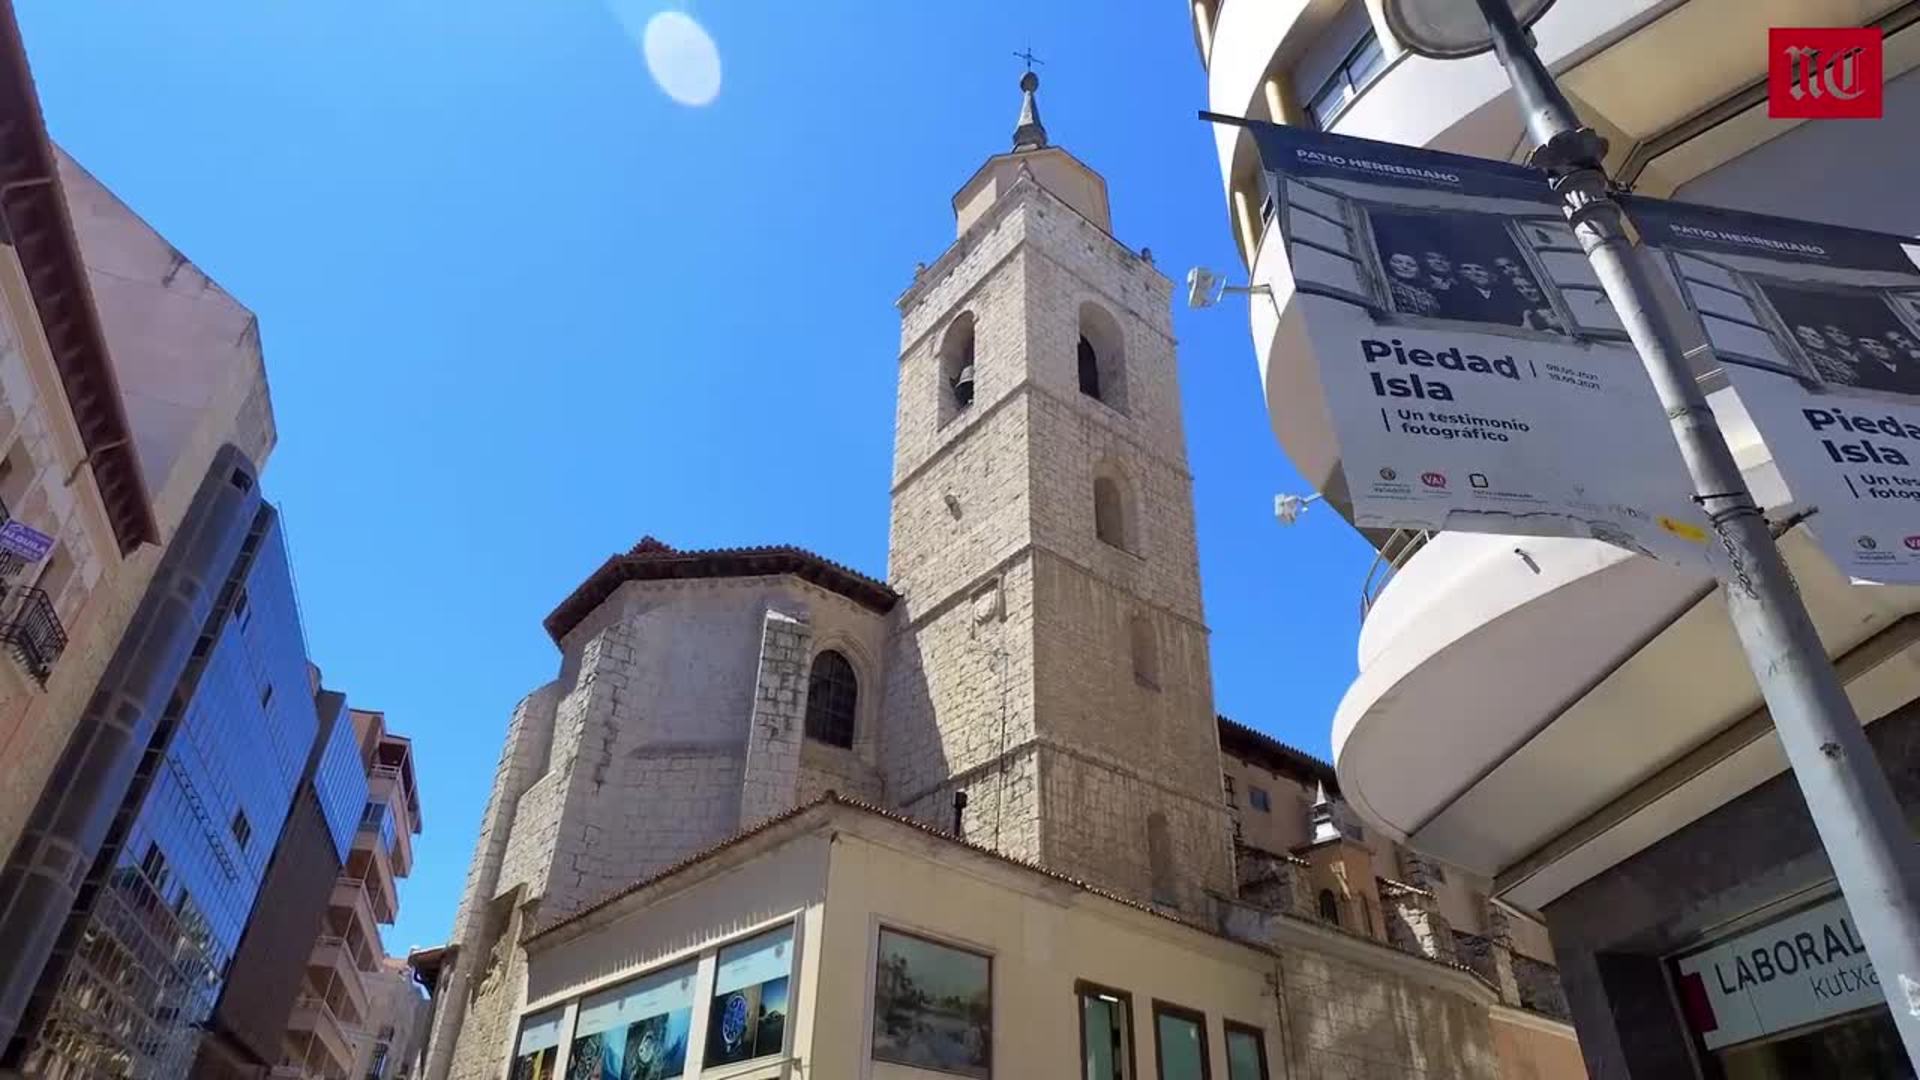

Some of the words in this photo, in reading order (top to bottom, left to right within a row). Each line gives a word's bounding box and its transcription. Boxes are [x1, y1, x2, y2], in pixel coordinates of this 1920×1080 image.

[1296, 149, 1346, 165] PATIO
[1349, 158, 1460, 183] HERRERIANO
[1669, 223, 1718, 239] PATIO
[1719, 231, 1825, 255] HERRERIANO
[1360, 338, 1521, 381] Piedad
[1370, 371, 1455, 402] Isla
[1397, 408, 1424, 422] Un
[1429, 411, 1531, 433] testimonio
[1400, 422, 1509, 443] fotográfico
[1802, 407, 1920, 440] Pieda
[1821, 439, 1910, 466] Isla
[1860, 474, 1890, 486] Un
[1868, 487, 1920, 501] fotog
[1714, 918, 1866, 996] LABORAL
[1809, 962, 1881, 1001] kutxa
